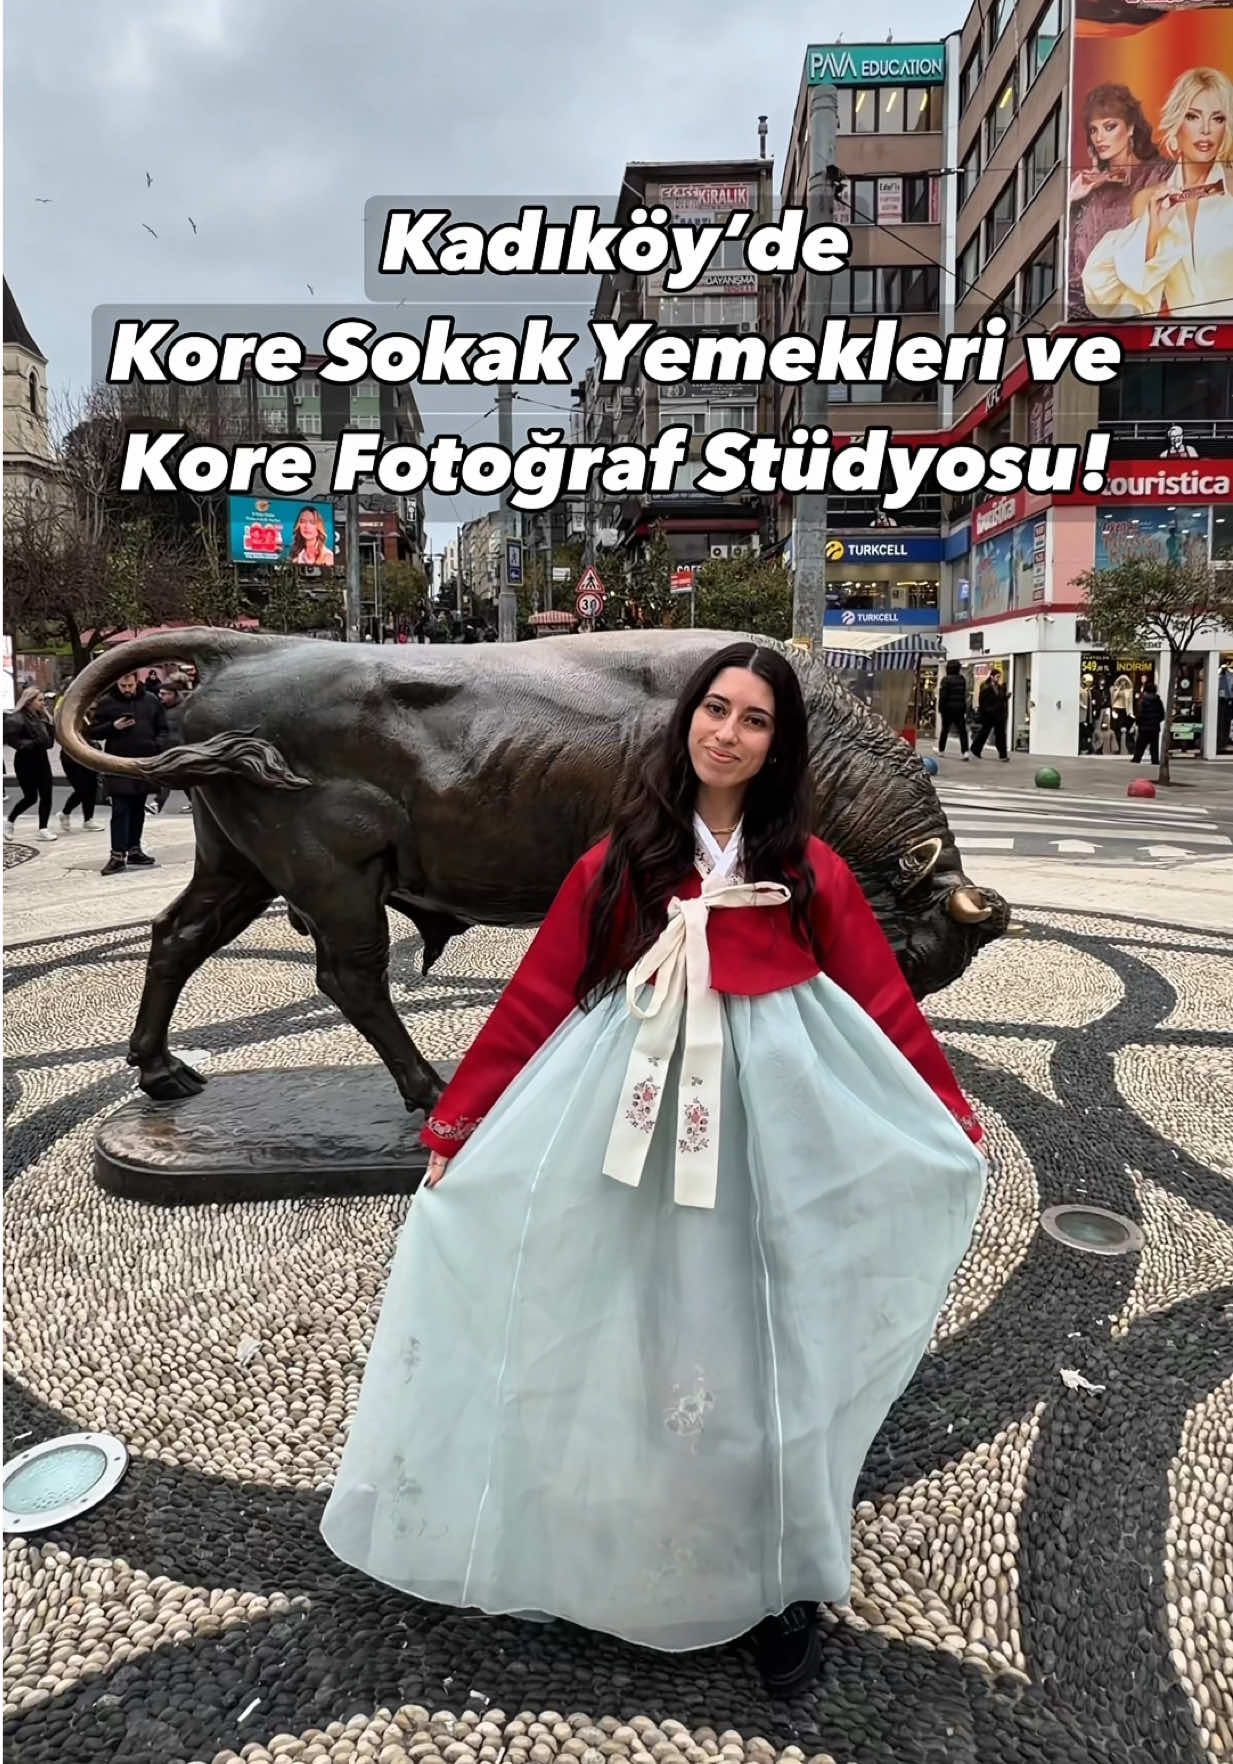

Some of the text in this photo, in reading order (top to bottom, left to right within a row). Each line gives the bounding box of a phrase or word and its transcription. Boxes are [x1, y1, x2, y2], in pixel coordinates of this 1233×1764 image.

[810, 51, 943, 79] PAVA EDUCATION
[1148, 325, 1217, 347] KFC
[847, 543, 908, 556] TURKCELL
[582, 599, 597, 611] 30
[857, 612, 899, 622] TURKCELL
